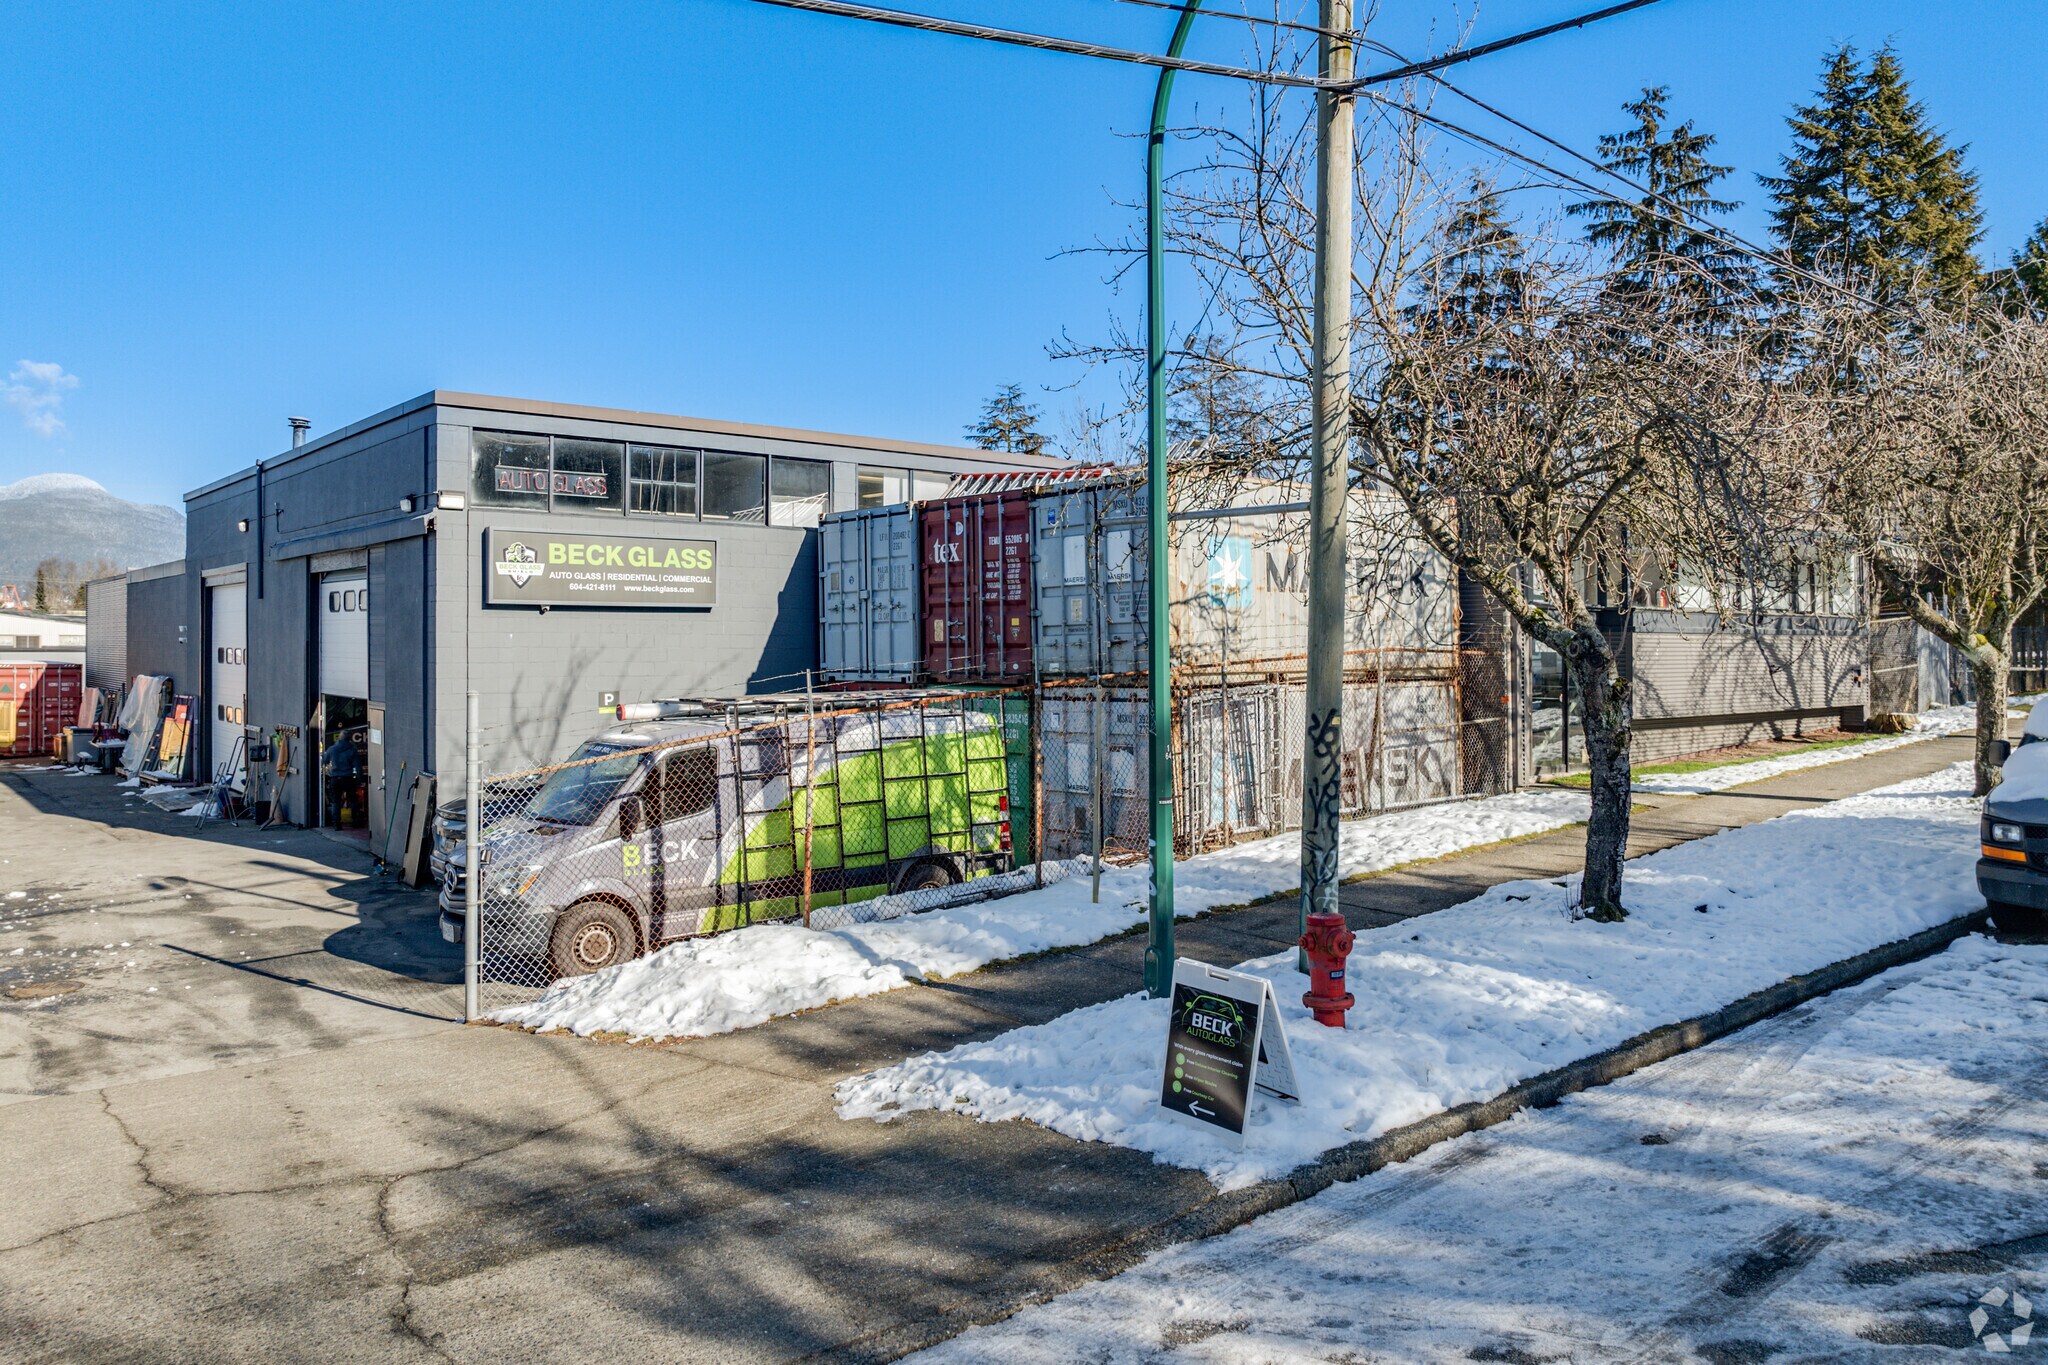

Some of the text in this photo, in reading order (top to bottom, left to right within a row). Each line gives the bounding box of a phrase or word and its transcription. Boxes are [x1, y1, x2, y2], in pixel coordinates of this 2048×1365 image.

[498, 471, 607, 495] AUTO GLASS
[548, 542, 713, 569] BECK GLASS
[933, 538, 960, 564] tex
[549, 571, 573, 580] AUTO
[574, 572, 601, 581] GLASS
[607, 573, 658, 582] RESIDENTIAL
[663, 575, 713, 583] COMMERCIAL
[569, 583, 694, 593] 604-421-8111 www.beckglass.com
[604, 693, 614, 706] P
[623, 838, 699, 868] BECK
[1192, 1012, 1233, 1037] BECK
[1186, 1026, 1236, 1048] AUTOGLASS
[1184, 1046, 1195, 1054] every
[1195, 1049, 1206, 1057] glass
[1206, 1053, 1232, 1065] replacement
